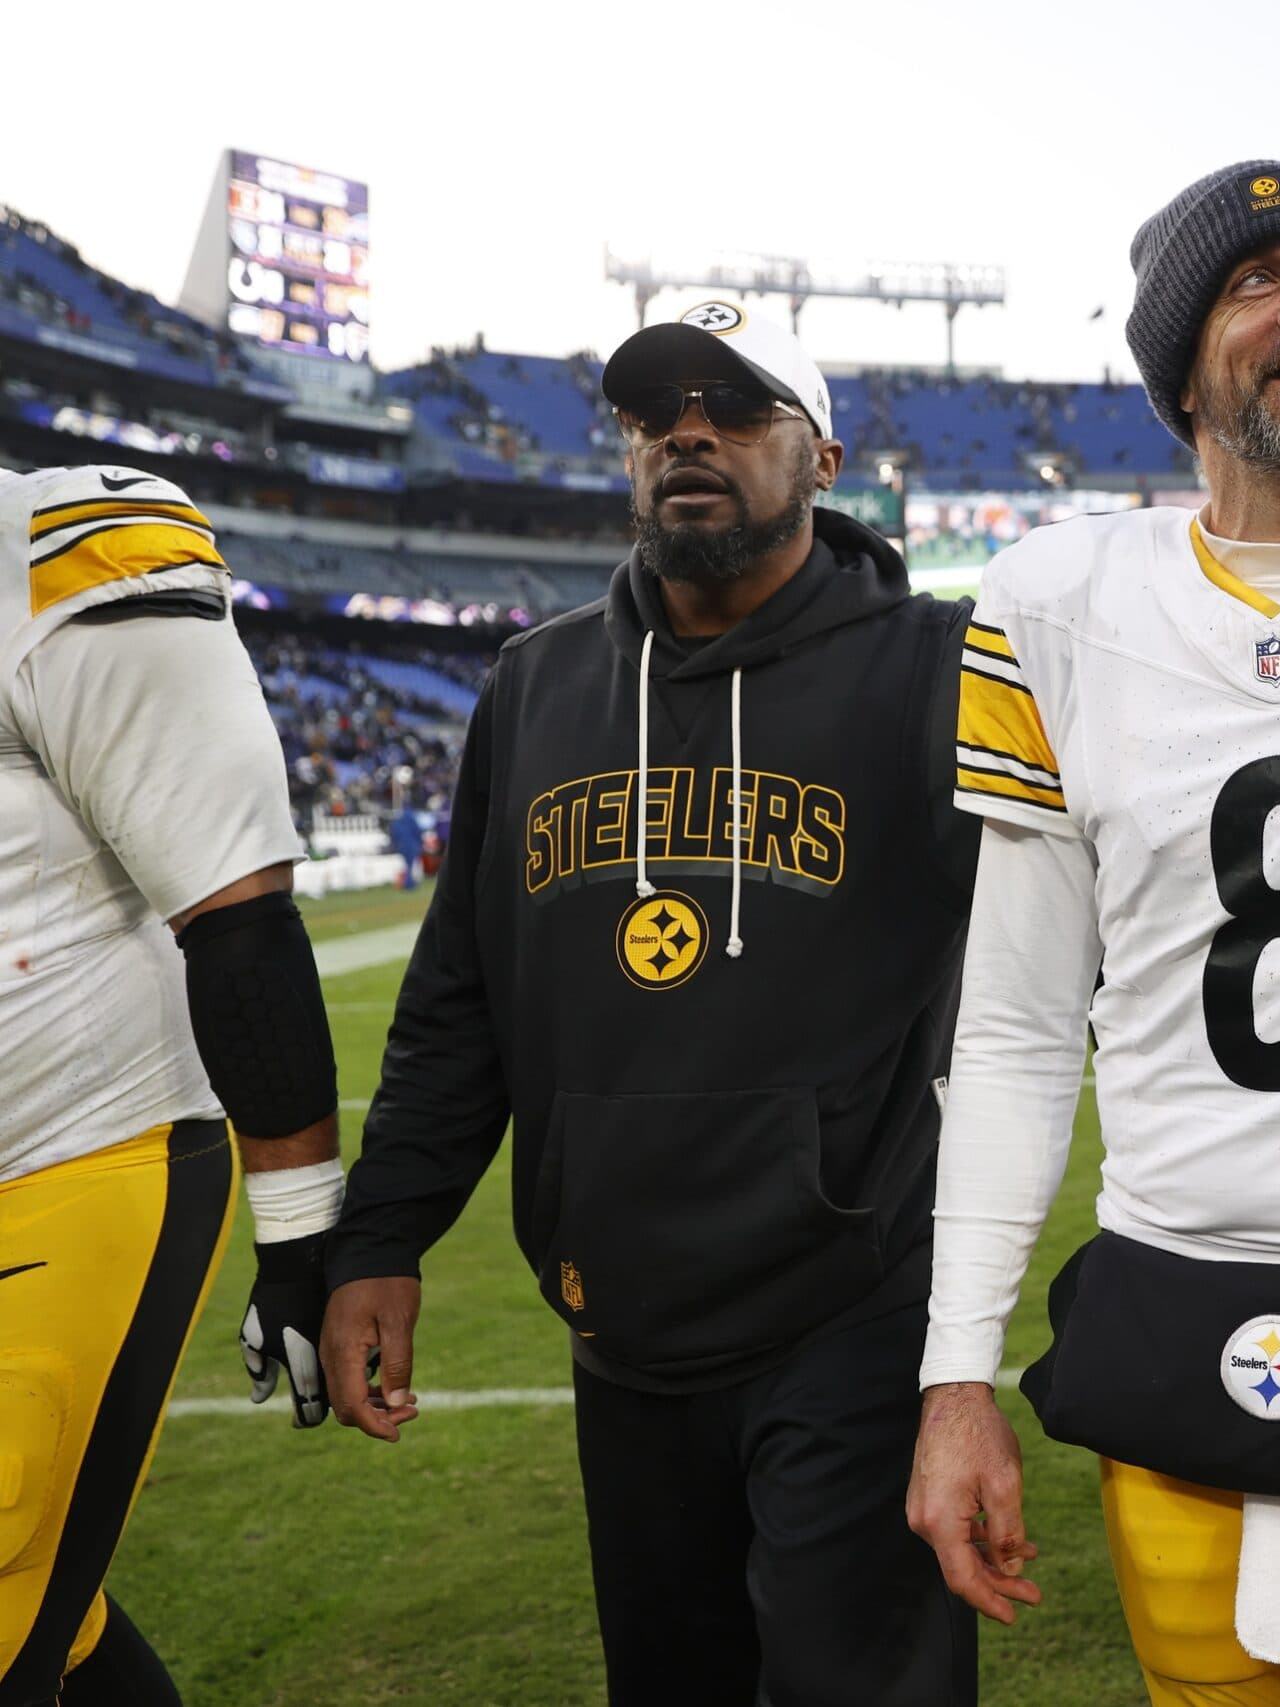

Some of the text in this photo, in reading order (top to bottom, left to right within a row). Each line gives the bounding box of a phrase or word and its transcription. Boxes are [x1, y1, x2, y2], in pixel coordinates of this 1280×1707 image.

[526, 767, 846, 895] STEELERS
[629, 933, 658, 945] Steelers
[1231, 1355, 1268, 1370] Steelers
